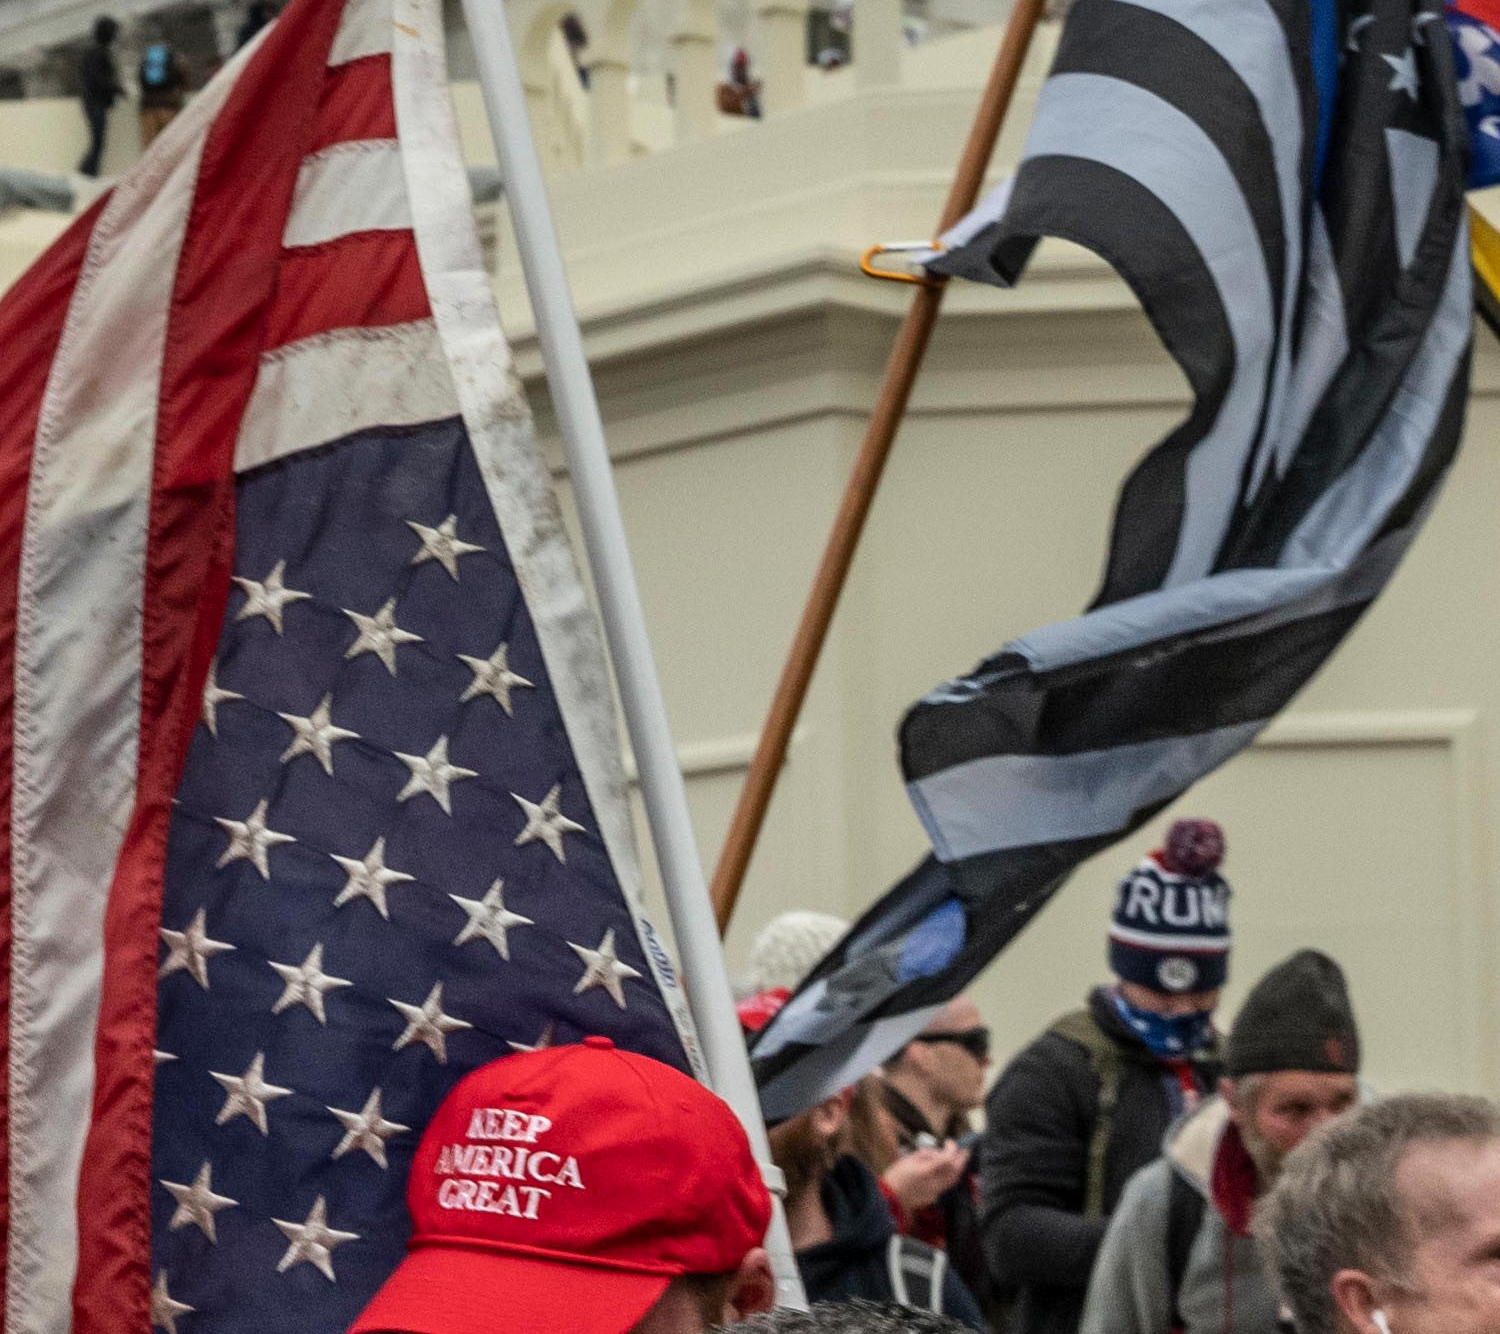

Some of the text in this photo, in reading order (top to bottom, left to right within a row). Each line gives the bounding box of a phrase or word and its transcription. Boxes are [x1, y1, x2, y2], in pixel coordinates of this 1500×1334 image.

[465, 1107, 553, 1144] KEEP
[434, 1143, 586, 1190] AMERICA
[437, 1178, 552, 1221] GREAT
